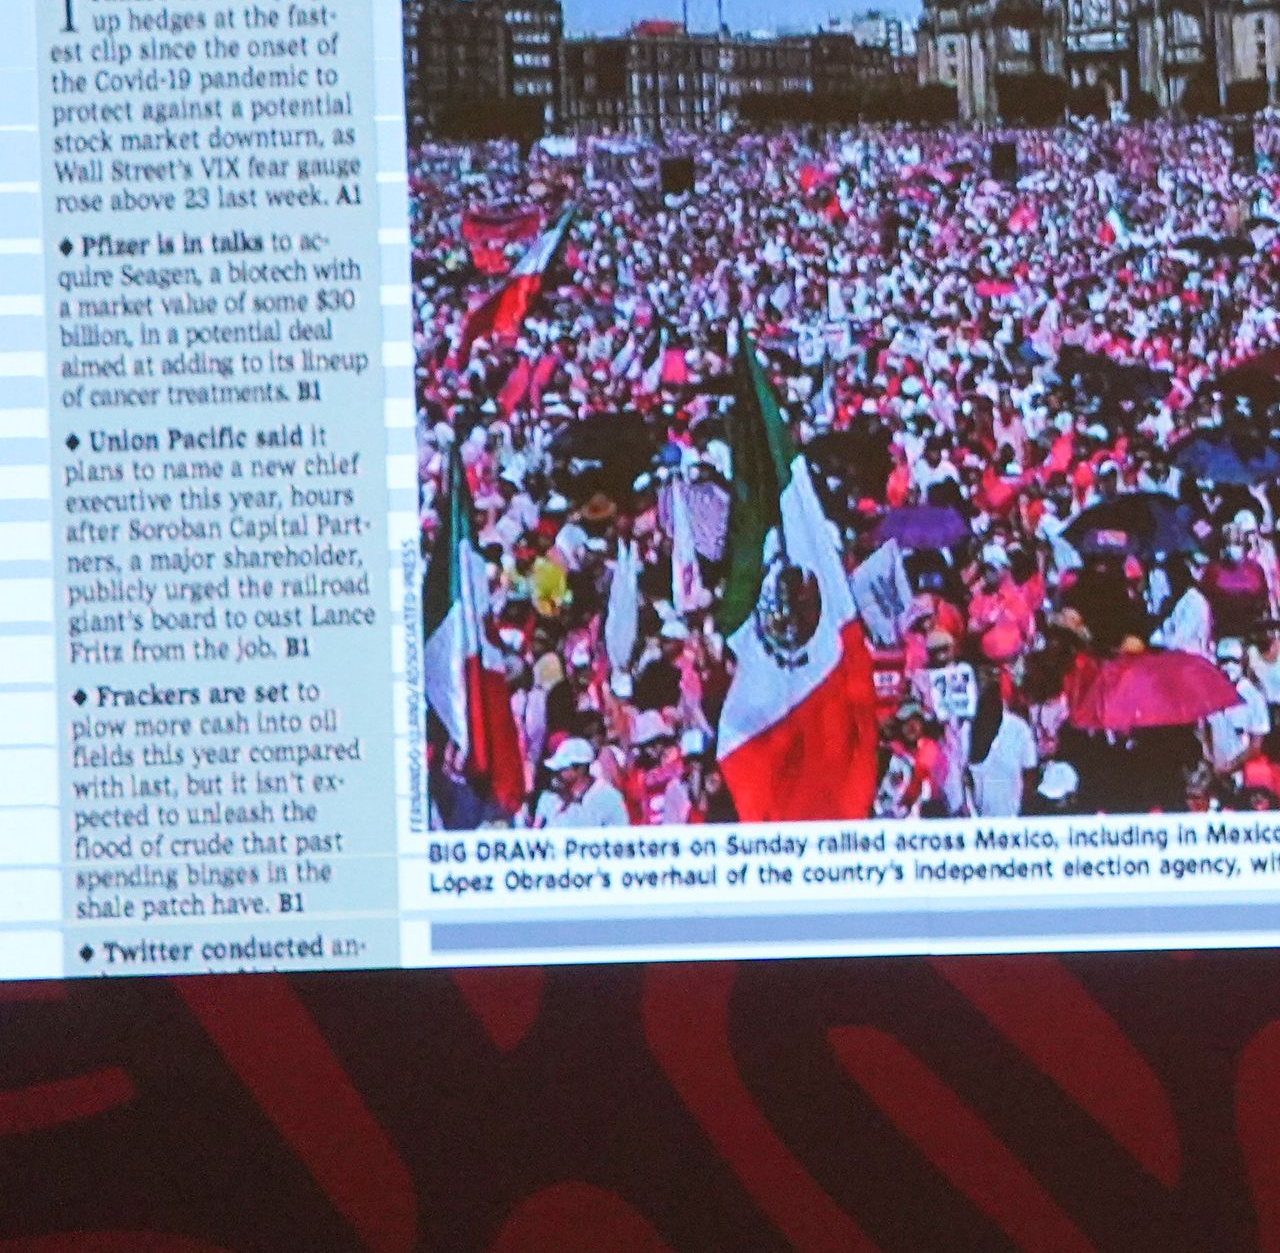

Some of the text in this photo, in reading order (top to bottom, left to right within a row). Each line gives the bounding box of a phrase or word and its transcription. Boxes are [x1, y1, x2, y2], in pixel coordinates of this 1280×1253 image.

[81, 230, 330, 258] Pfizer is in talks to ac-
[89, 424, 326, 454] Union Pacific said it
[96, 682, 320, 708] Frackers are set to
[429, 840, 467, 865] BIG
[476, 838, 555, 863] DRAW:
[565, 838, 680, 859] Protesters
[690, 838, 716, 857] on
[727, 833, 808, 858] Sunday
[818, 830, 885, 853] rallied
[895, 833, 966, 851] across
[974, 827, 1059, 850] Mexico,
[1069, 825, 1167, 851] including
[1178, 824, 1197, 845] in
[430, 872, 494, 897] López
[505, 867, 611, 892] Obrador's
[622, 864, 717, 888] overhaul
[727, 863, 749, 886] of
[759, 862, 793, 884] the
[803, 859, 904, 886] country's
[914, 858, 1053, 884] independent
[1063, 855, 1149, 877] election
[1160, 857, 1240, 880] agency,
[102, 935, 365, 963] Twitter conducted an-
